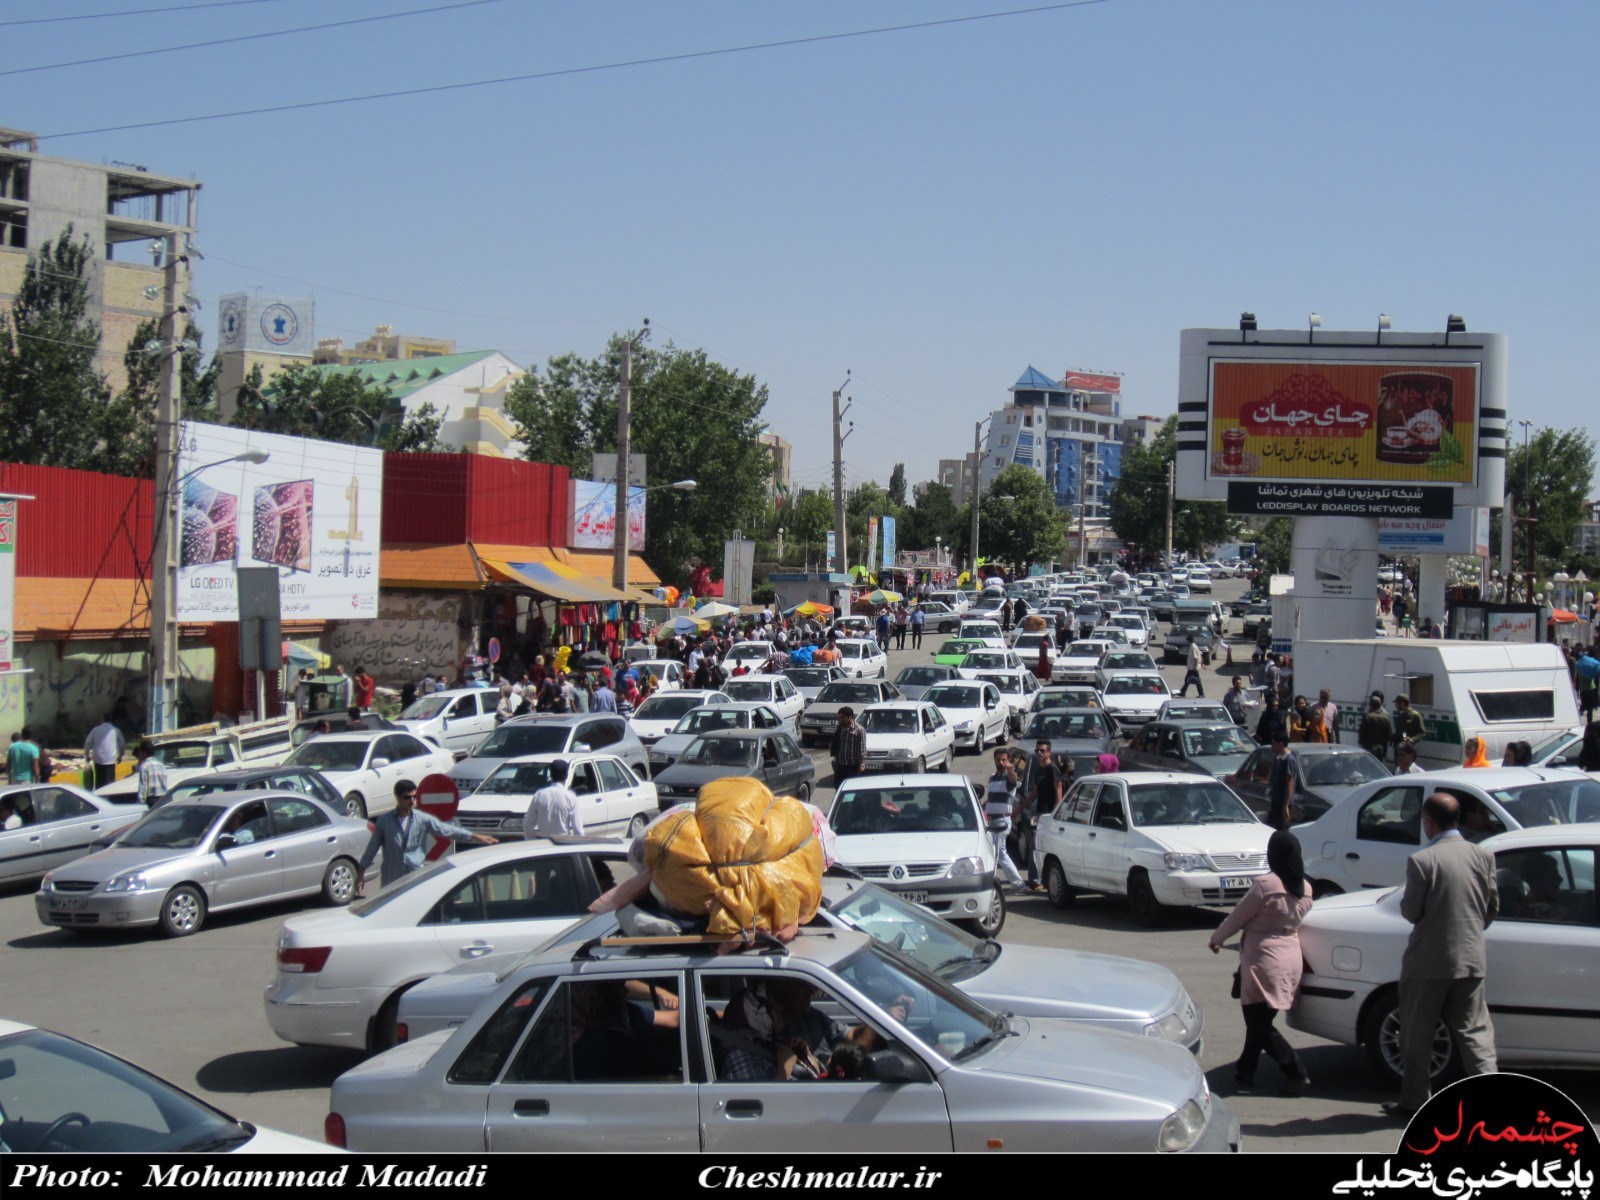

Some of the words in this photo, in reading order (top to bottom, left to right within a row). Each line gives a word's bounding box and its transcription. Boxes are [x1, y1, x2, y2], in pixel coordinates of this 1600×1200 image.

[1253, 402, 1314, 428] جهان
[1314, 403, 1369, 428] چای
[1258, 484, 1288, 497] تماشا
[1289, 485, 1323, 498] شهری
[1324, 487, 1346, 499] های
[1348, 487, 1390, 501] تلویزیون
[1392, 487, 1424, 501] شبکه
[1256, 501, 1319, 511] LEDDISPLAY
[1321, 503, 1366, 513] BOARDS
[1368, 504, 1421, 514] NETWORK
[318, 563, 342, 578] تصویر
[355, 563, 371, 578] غرق
[190, 577, 201, 589] LG
[202, 577, 223, 589] OLED
[224, 577, 234, 589] TV
[287, 583, 306, 594] HDTV
